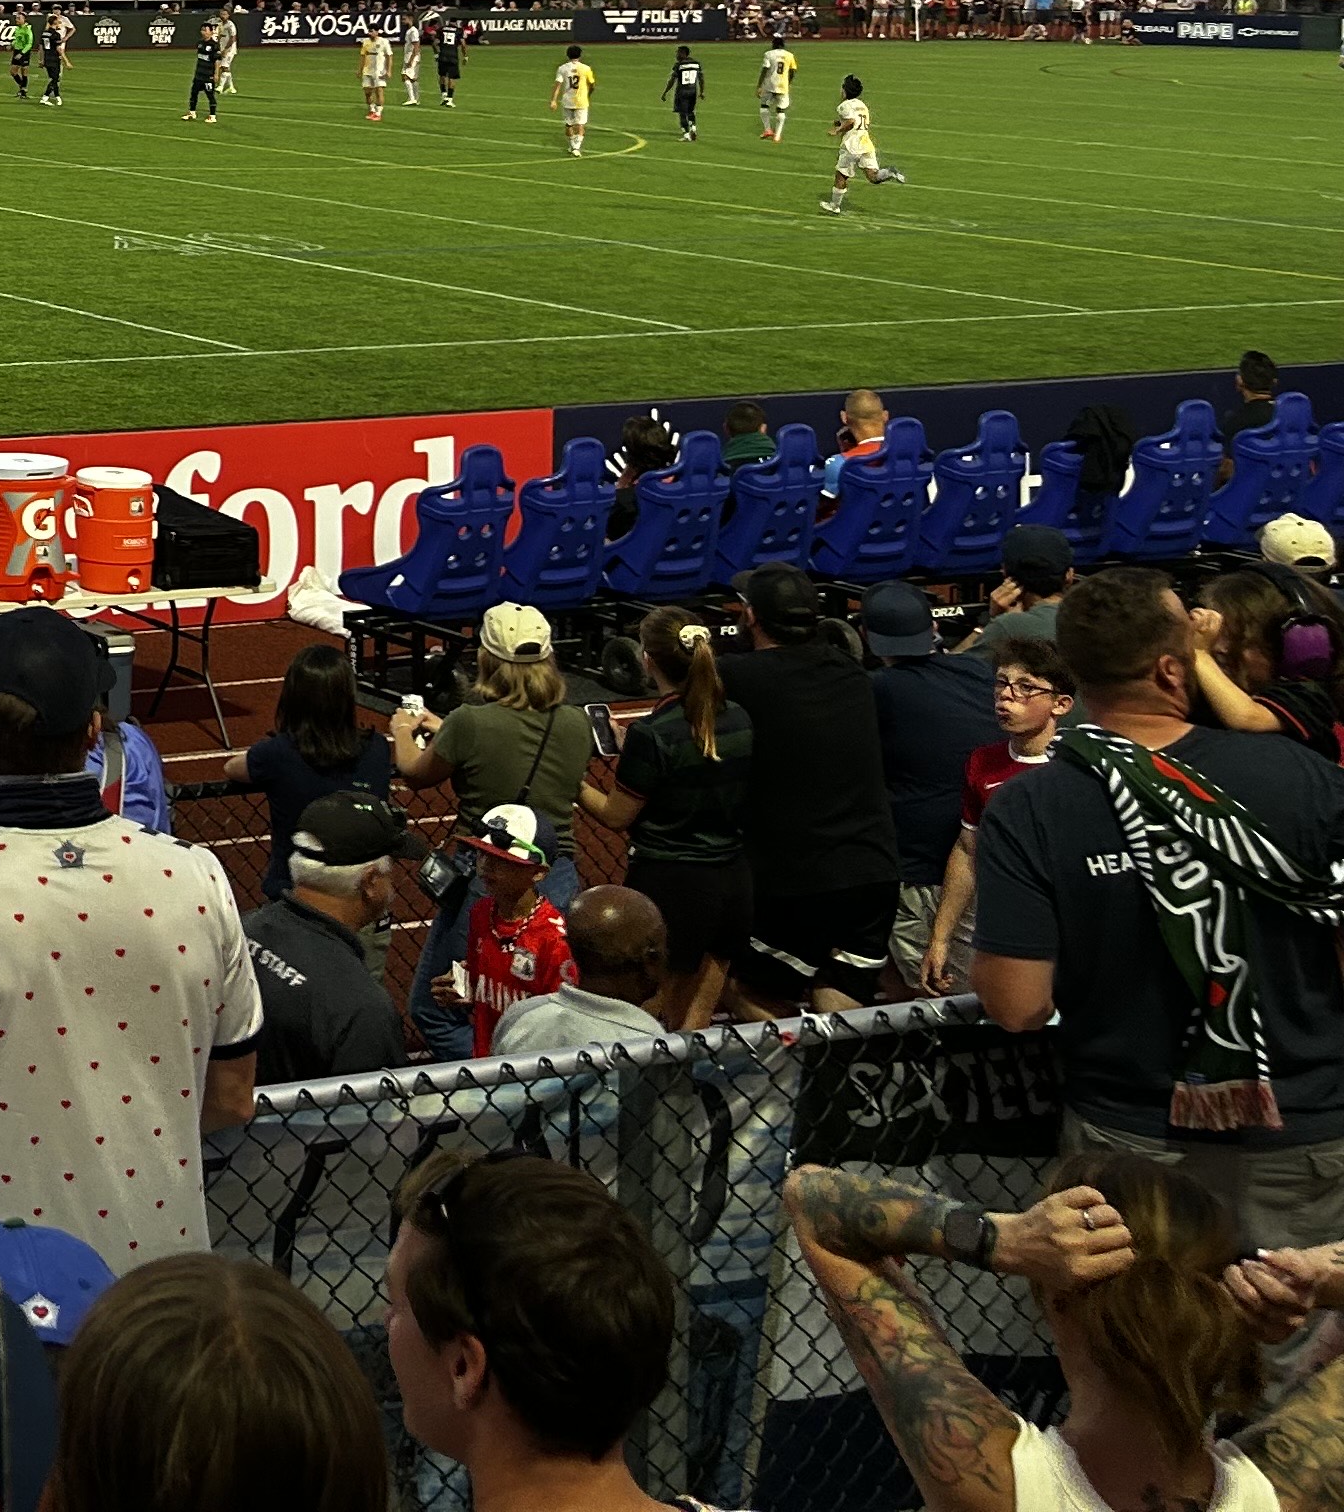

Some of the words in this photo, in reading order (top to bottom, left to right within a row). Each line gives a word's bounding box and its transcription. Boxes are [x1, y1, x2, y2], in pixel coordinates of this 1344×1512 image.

[305, 14, 402, 36] YOSAKU
[480, 18, 526, 32] VILLAGE
[527, 18, 574, 31] MARKET
[641, 9, 703, 24] FOLEY'S
[1176, 21, 1234, 40] PAPE
[21, 497, 56, 540] G
[930, 606, 965, 618] ORZA
[1086, 850, 1137, 877] HEA
[258, 948, 308, 987] STAFF
[846, 1046, 1062, 1128] SIXTEE
